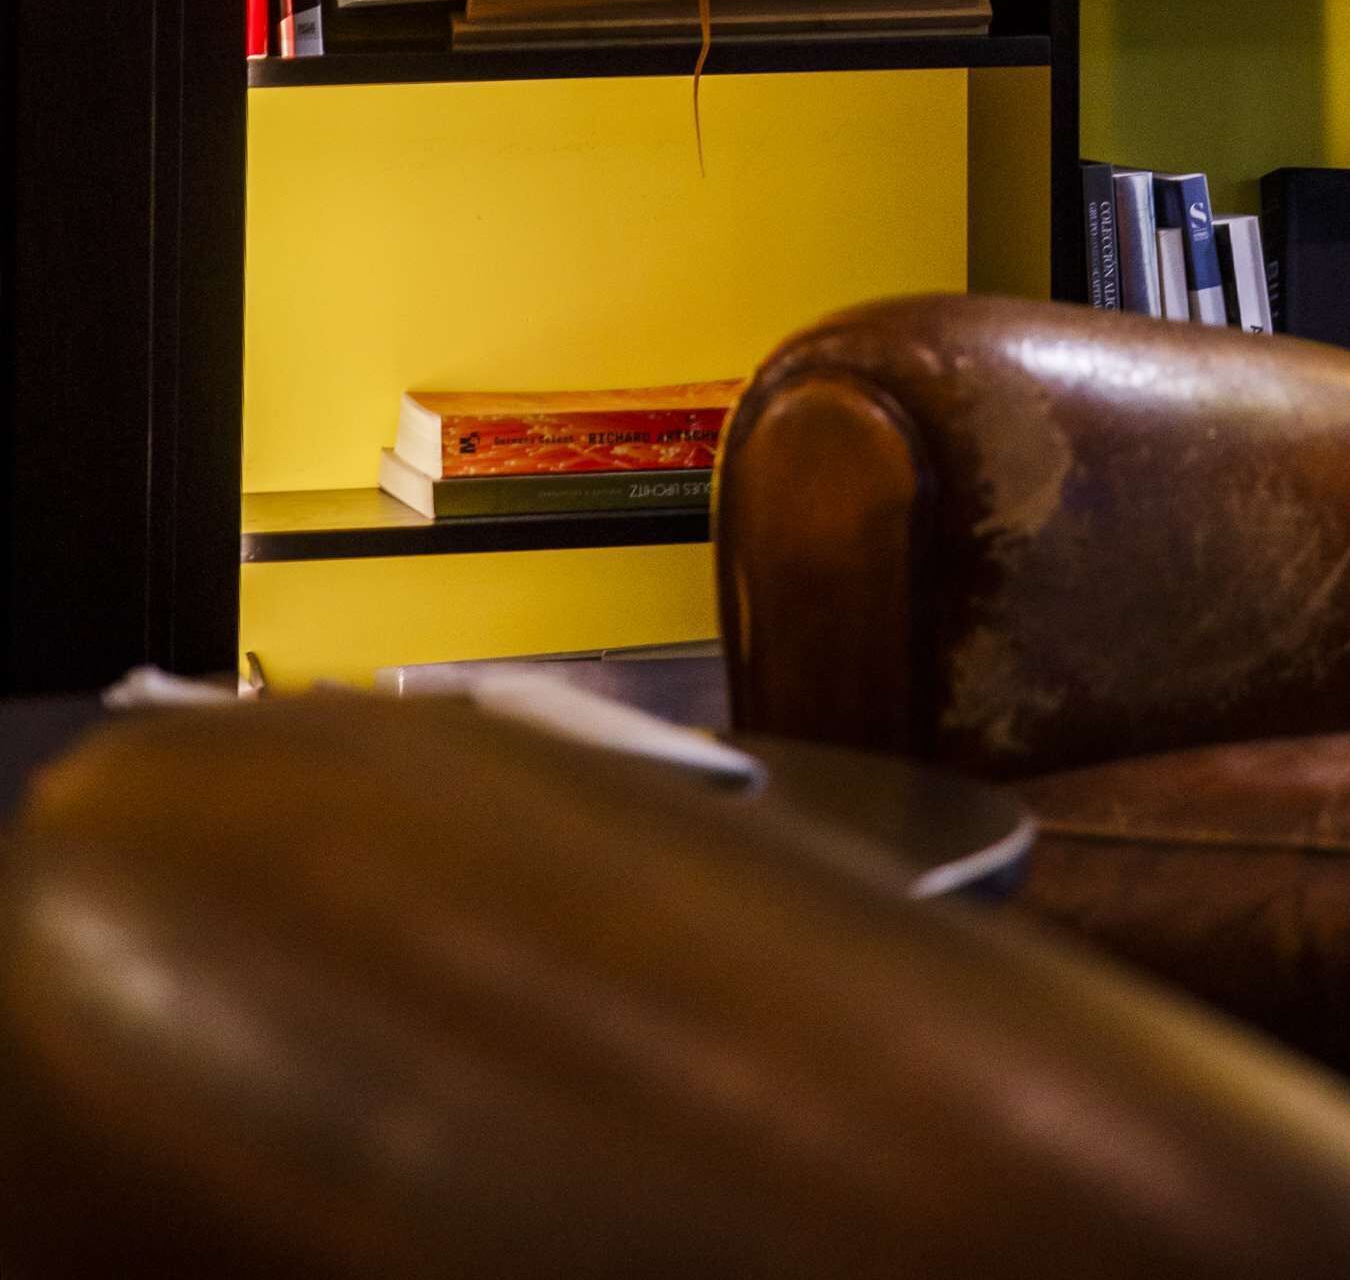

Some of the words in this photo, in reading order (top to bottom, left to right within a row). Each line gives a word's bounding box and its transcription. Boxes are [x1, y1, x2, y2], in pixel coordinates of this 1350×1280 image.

[1099, 201, 1114, 277] COLECCIÓN
[587, 430, 649, 446] RICHARD
[627, 480, 680, 499] LIPCHITZ
